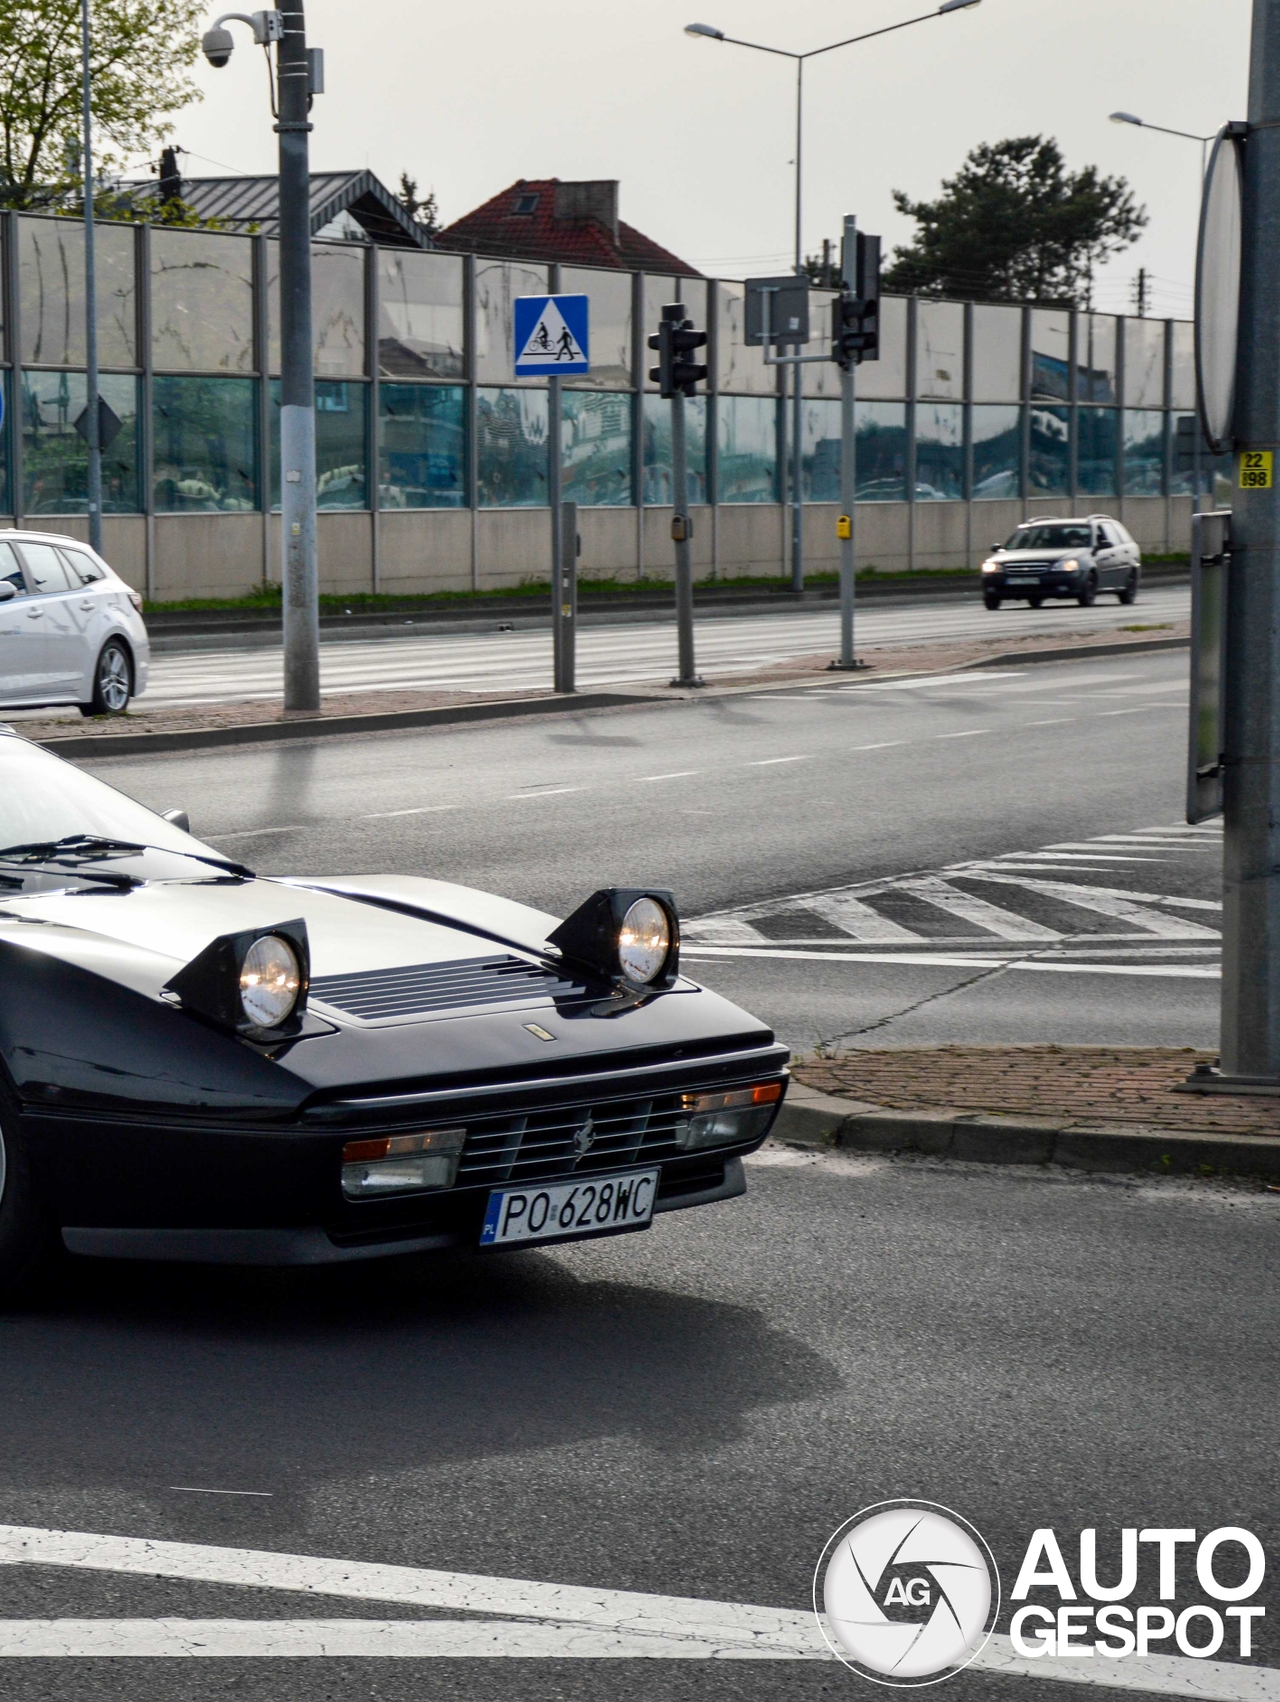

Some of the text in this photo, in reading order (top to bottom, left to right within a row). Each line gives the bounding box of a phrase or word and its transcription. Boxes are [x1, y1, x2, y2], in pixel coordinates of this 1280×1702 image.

[1245, 453, 1263, 468] 22
[501, 1176, 652, 1237] PO 628WC
[482, 1223, 495, 1236] PL
